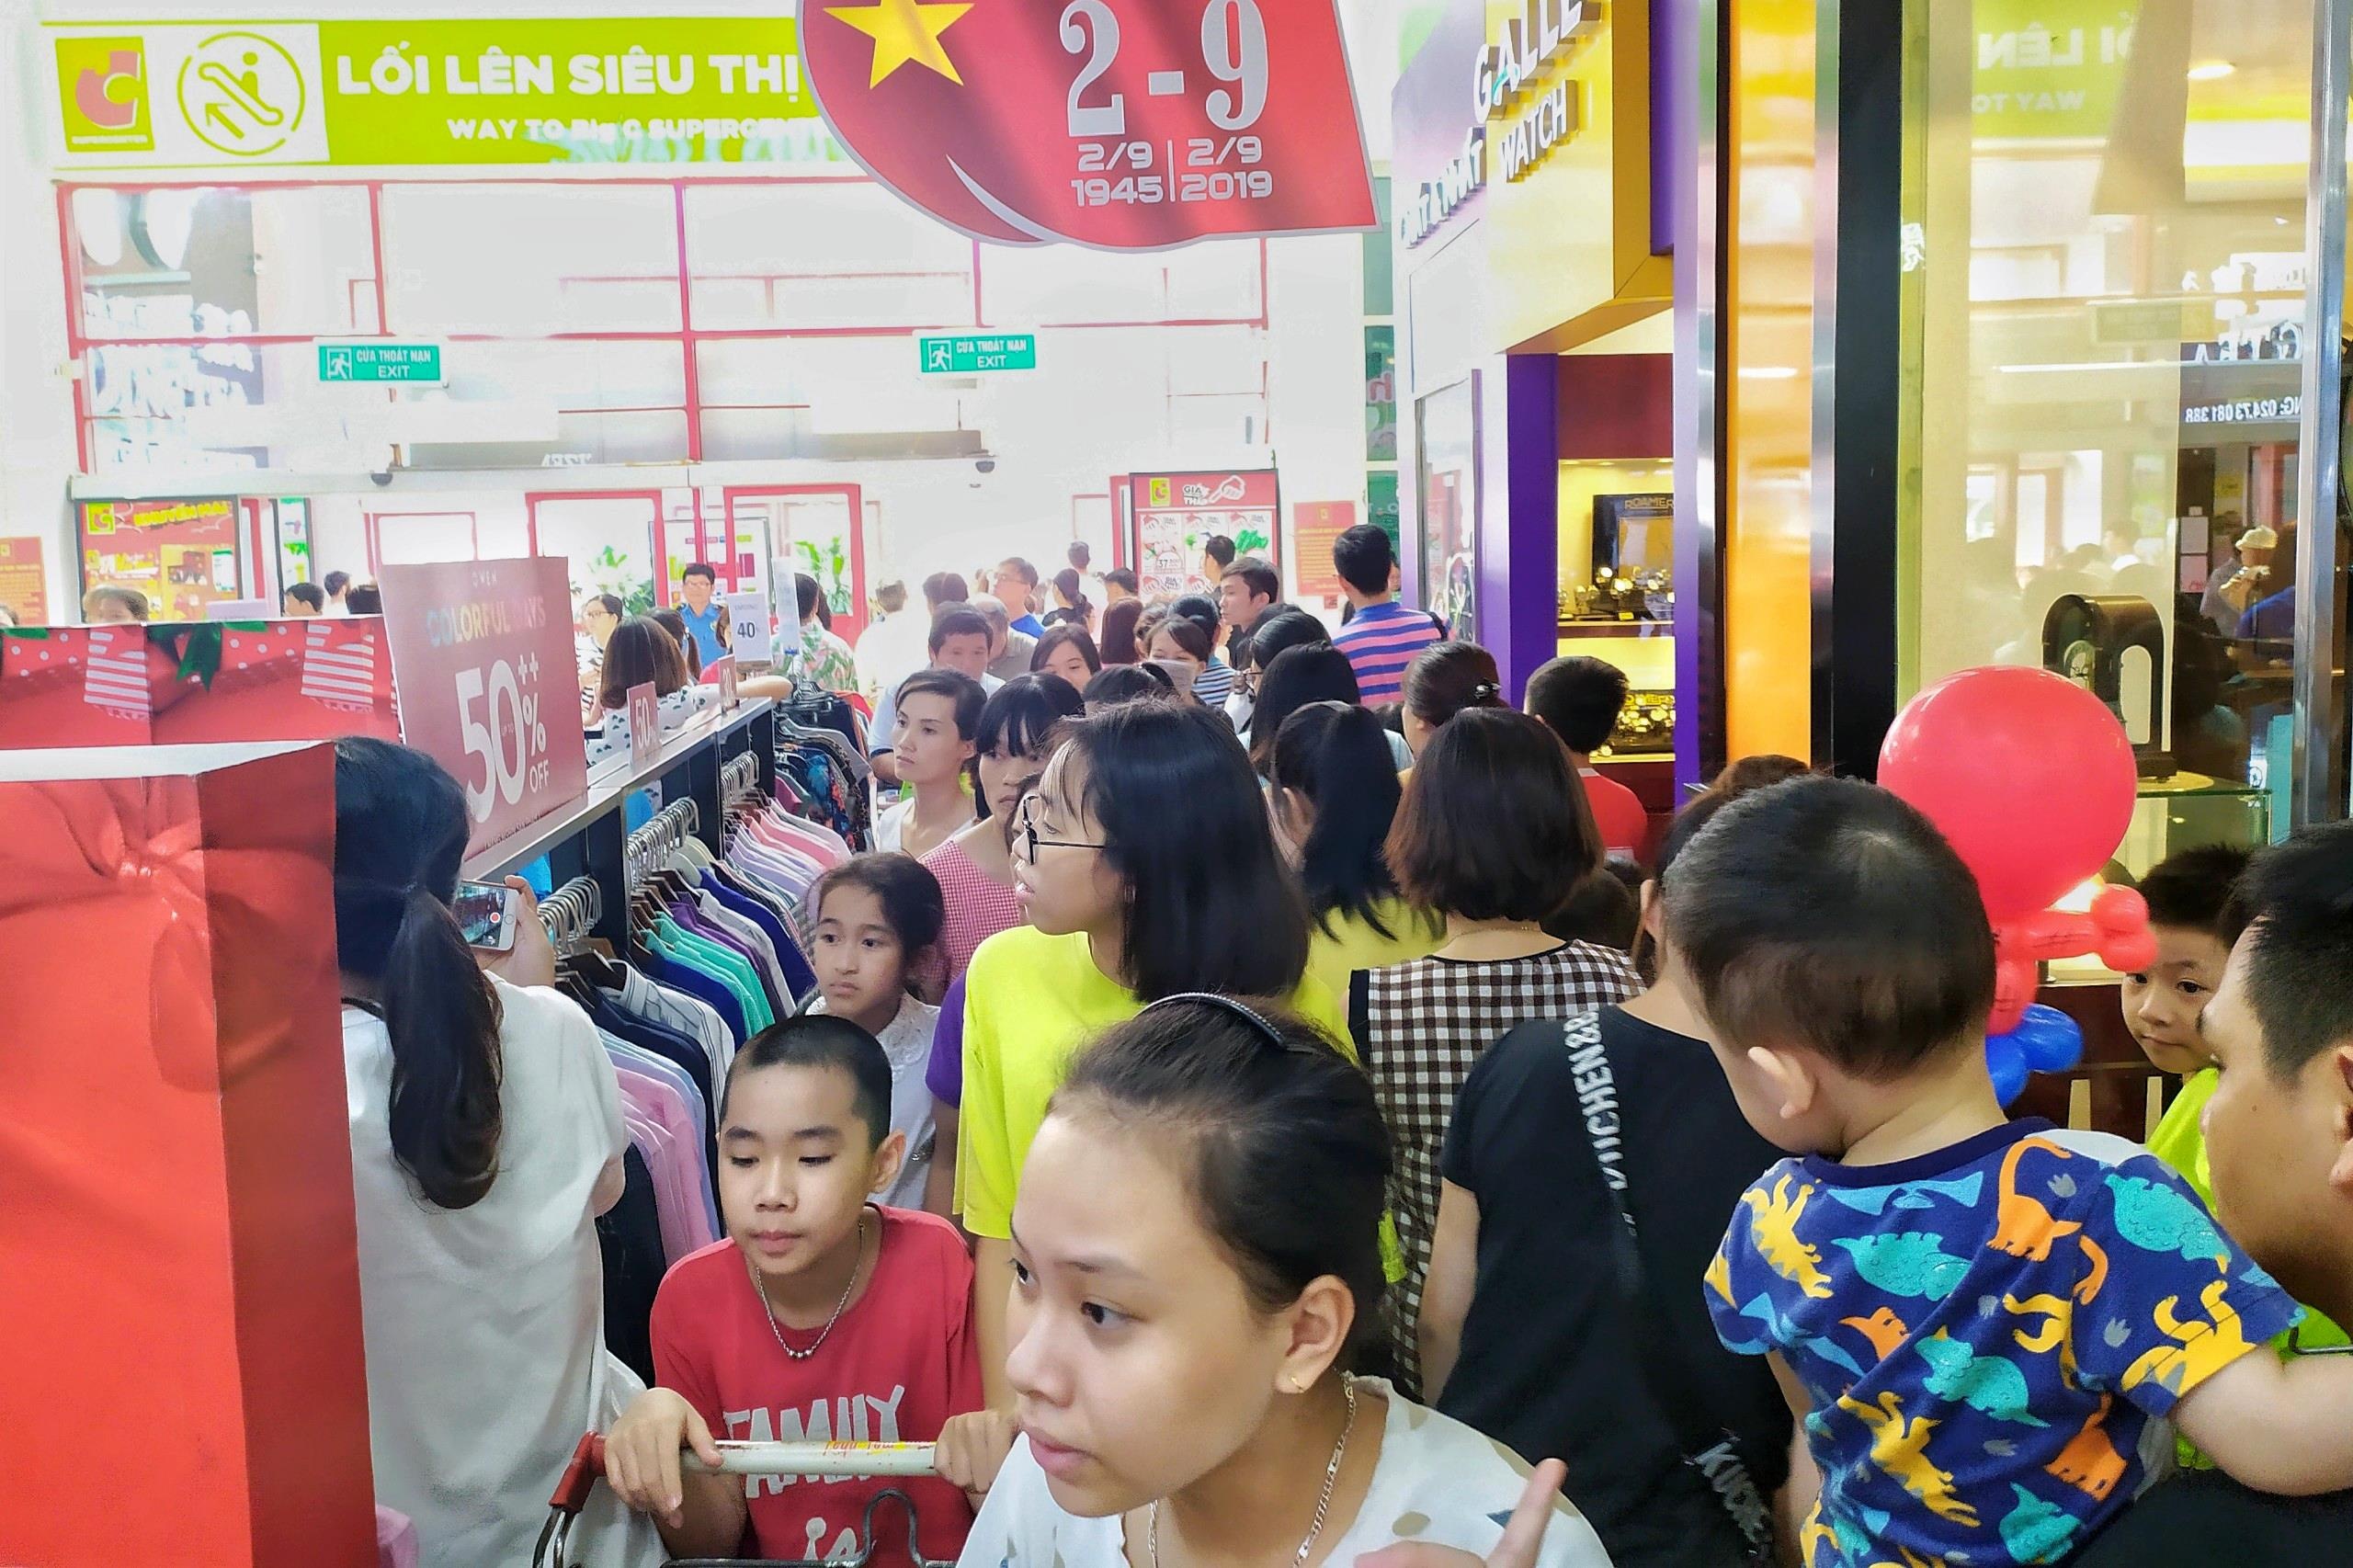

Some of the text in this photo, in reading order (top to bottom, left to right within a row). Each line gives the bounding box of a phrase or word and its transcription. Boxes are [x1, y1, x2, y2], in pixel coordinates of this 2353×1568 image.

[336, 40, 800, 103] LỐI LÊN SIÊU THỊ
[447, 118, 516, 140] WAY
[525, 119, 566, 140] TO
[621, 118, 643, 139] C
[1500, 80, 1567, 185] WATCH
[1077, 135, 1263, 173] 2/9 2/9
[1070, 170, 1274, 207] 1945 2019
[378, 365, 411, 379] EXIT
[977, 355, 1006, 368] EXIT
[426, 598, 511, 648] COLORFUL
[737, 621, 756, 639] 40
[529, 758, 550, 795] OFF
